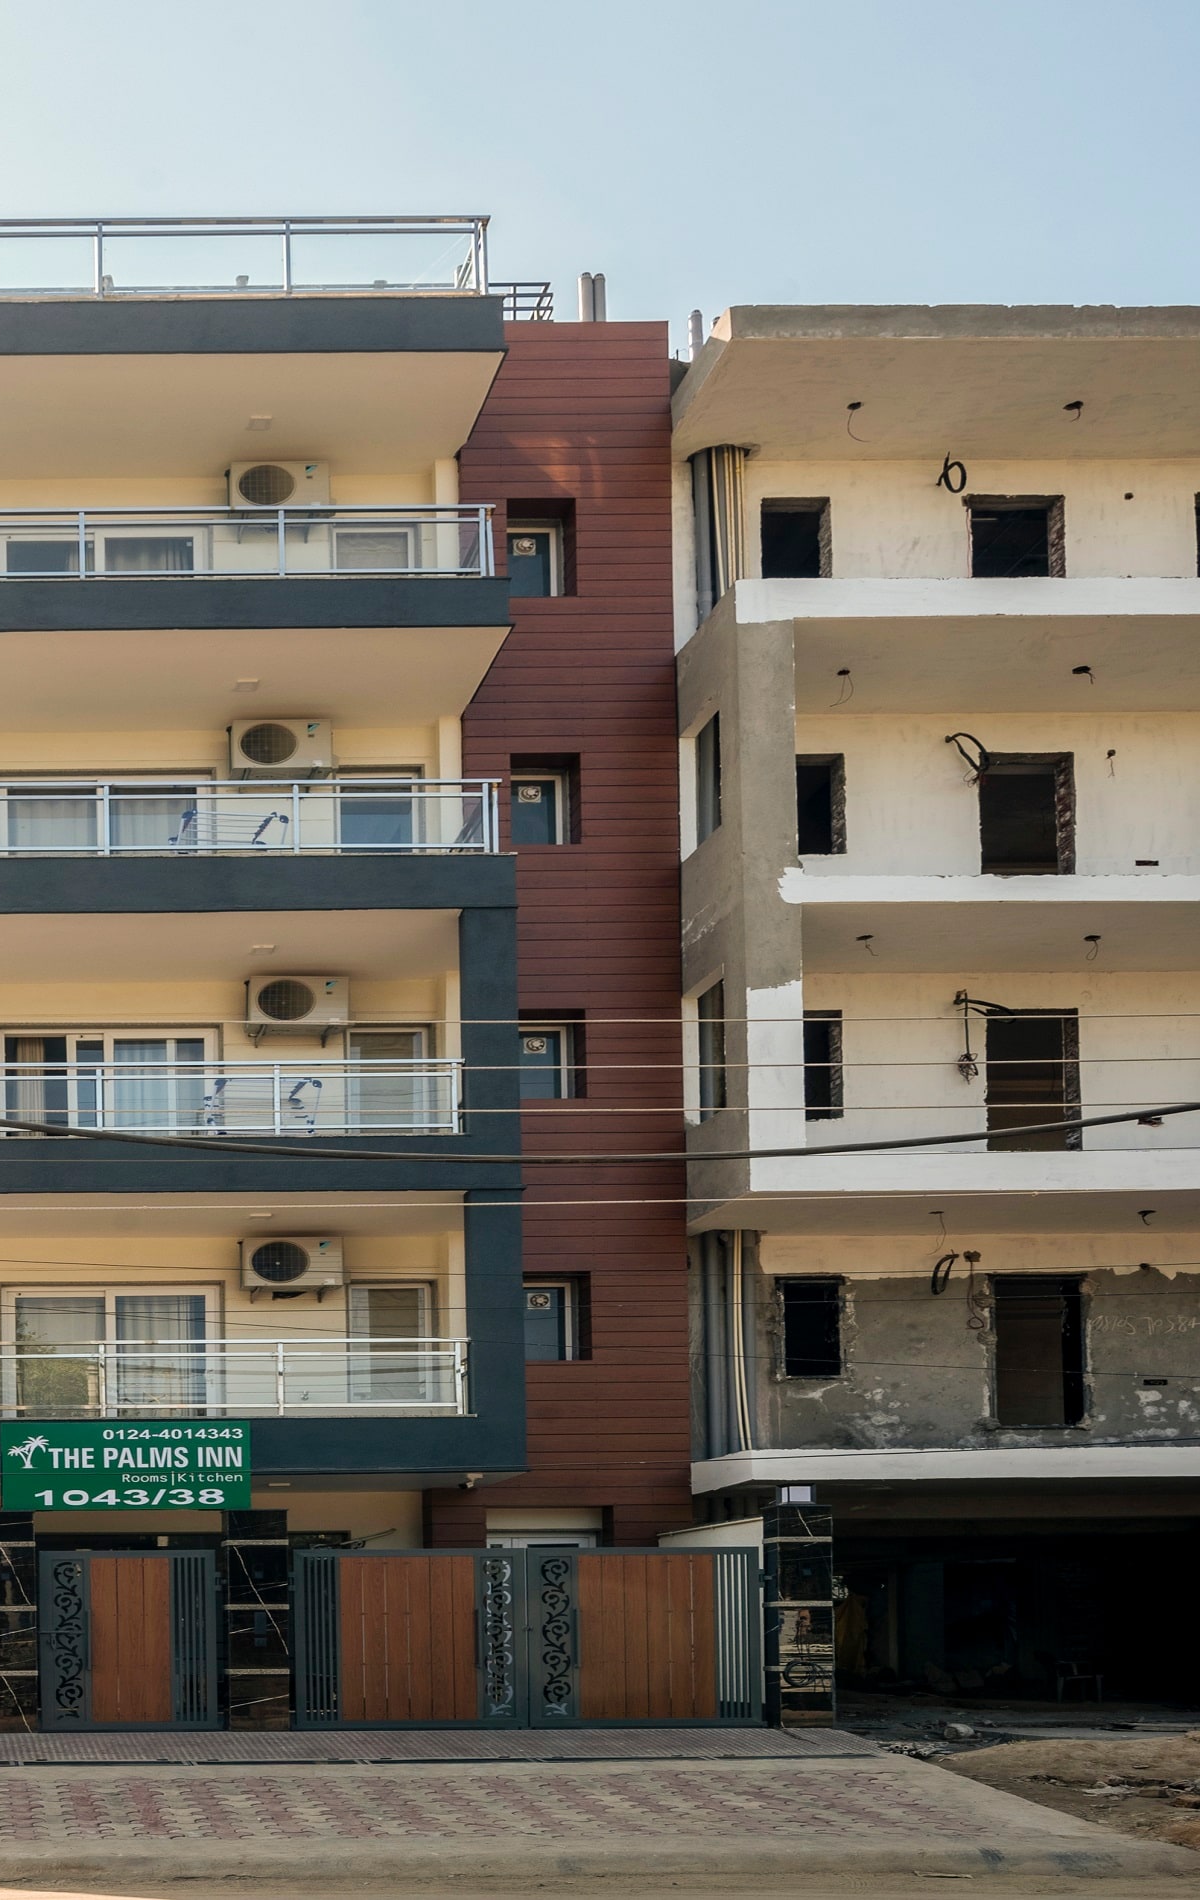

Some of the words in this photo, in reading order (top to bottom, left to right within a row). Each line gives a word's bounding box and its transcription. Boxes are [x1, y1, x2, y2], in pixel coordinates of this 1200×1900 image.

[102, 1428, 244, 1440] 0124-4014343
[48, 1447, 95, 1469] THE
[103, 1446, 189, 1468] PALMS
[197, 1446, 243, 1468] INN
[34, 1488, 225, 1506] 1043/38
